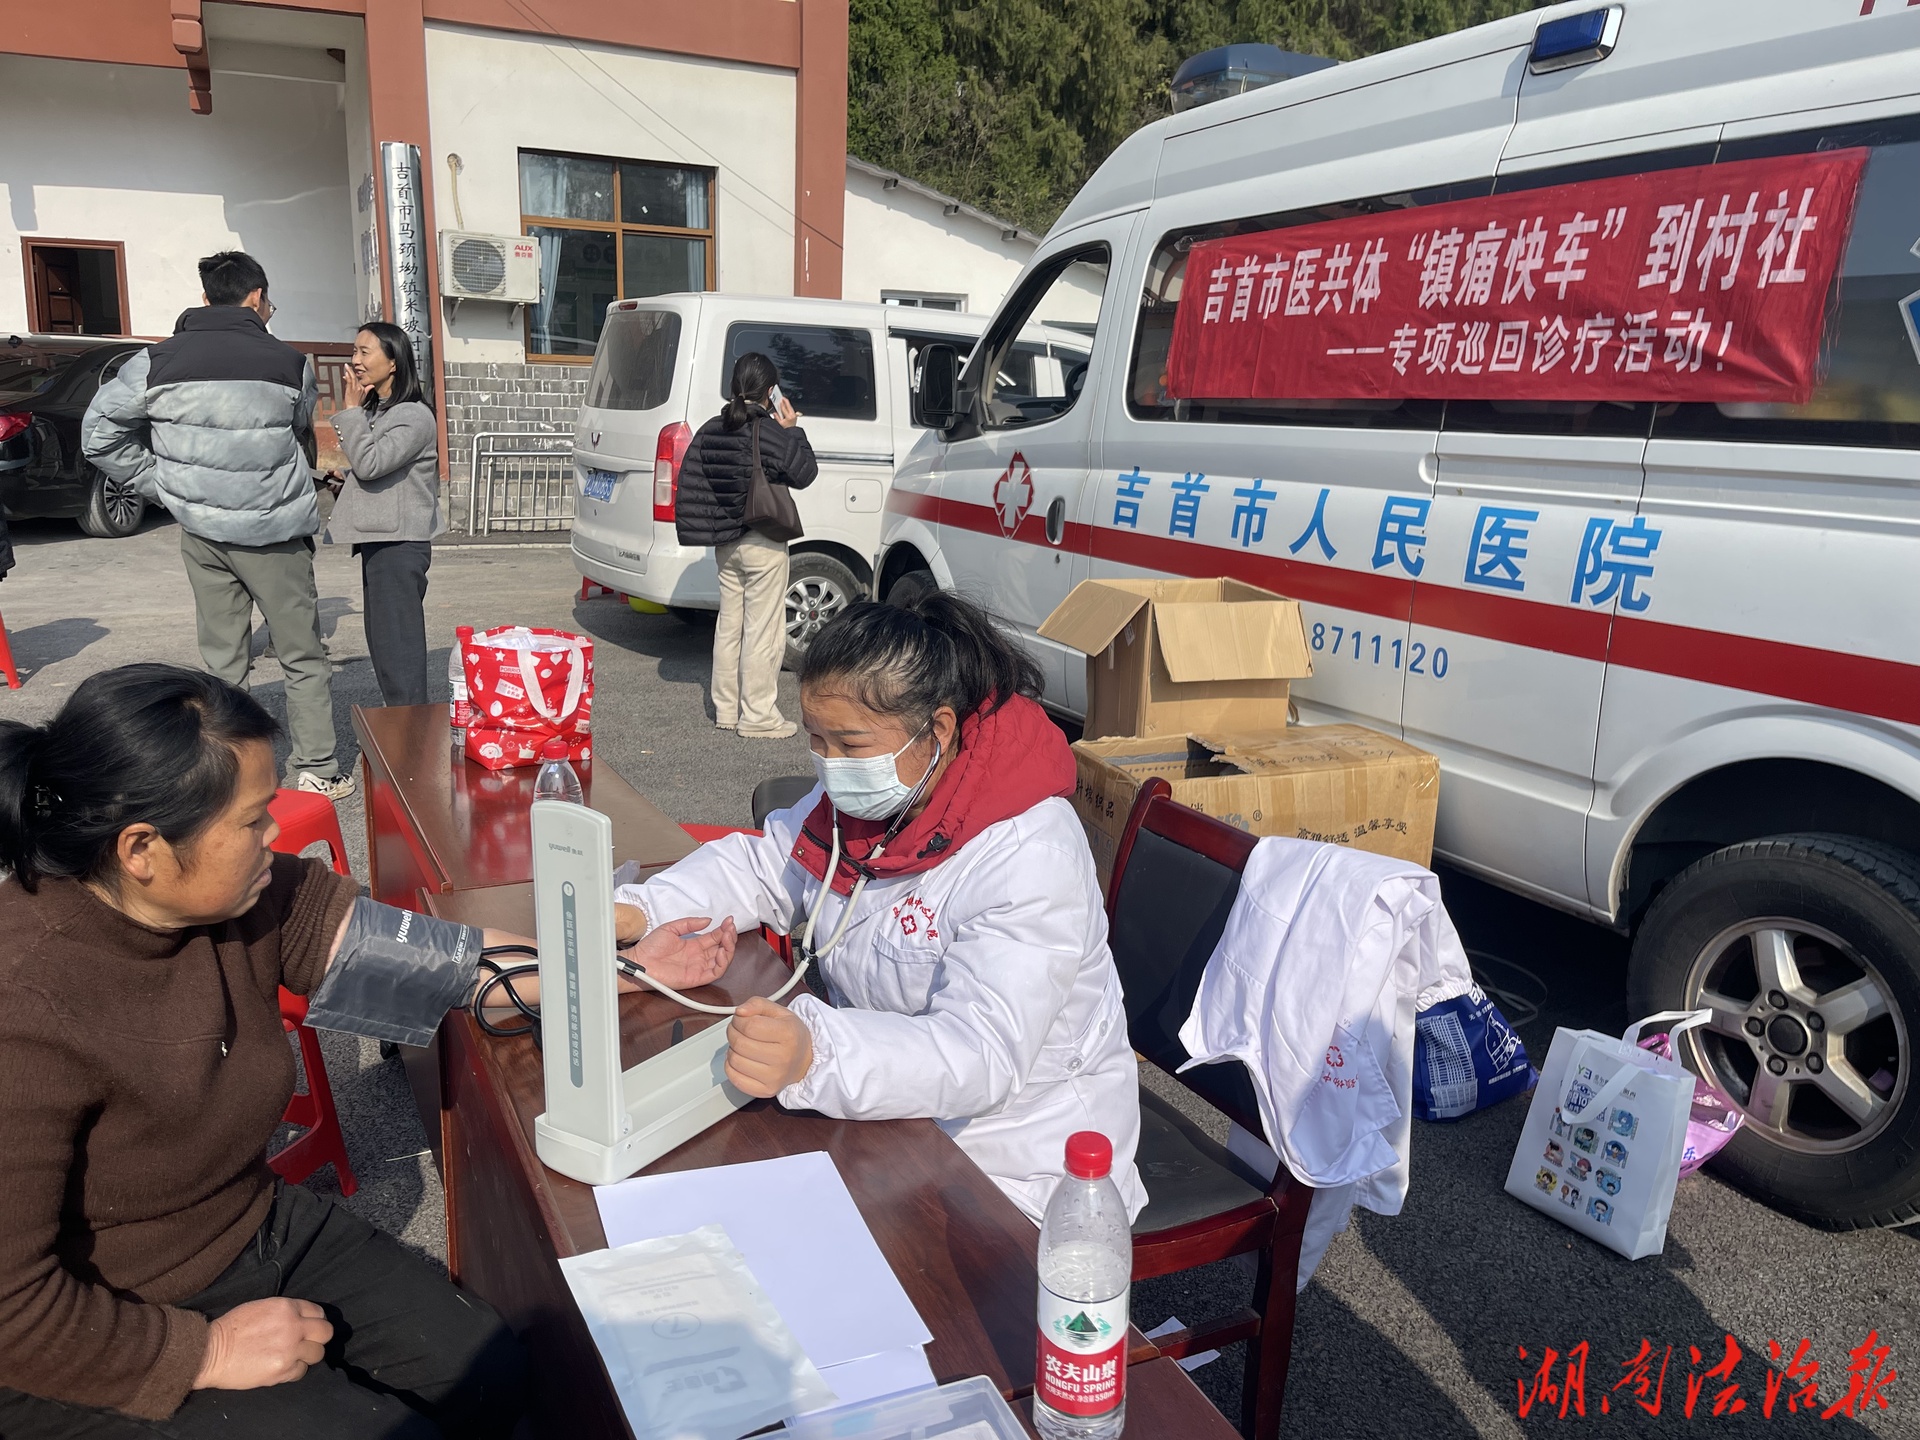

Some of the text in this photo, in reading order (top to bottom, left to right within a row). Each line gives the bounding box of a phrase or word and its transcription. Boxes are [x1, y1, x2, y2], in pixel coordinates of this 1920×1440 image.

[1113, 466, 1662, 612] 吉首市人民医院
[1311, 622, 1449, 678] 8711120
[1045, 1354, 1116, 1383] 农夫山泉
[1045, 1372, 1116, 1394] NONGFU SPRING
